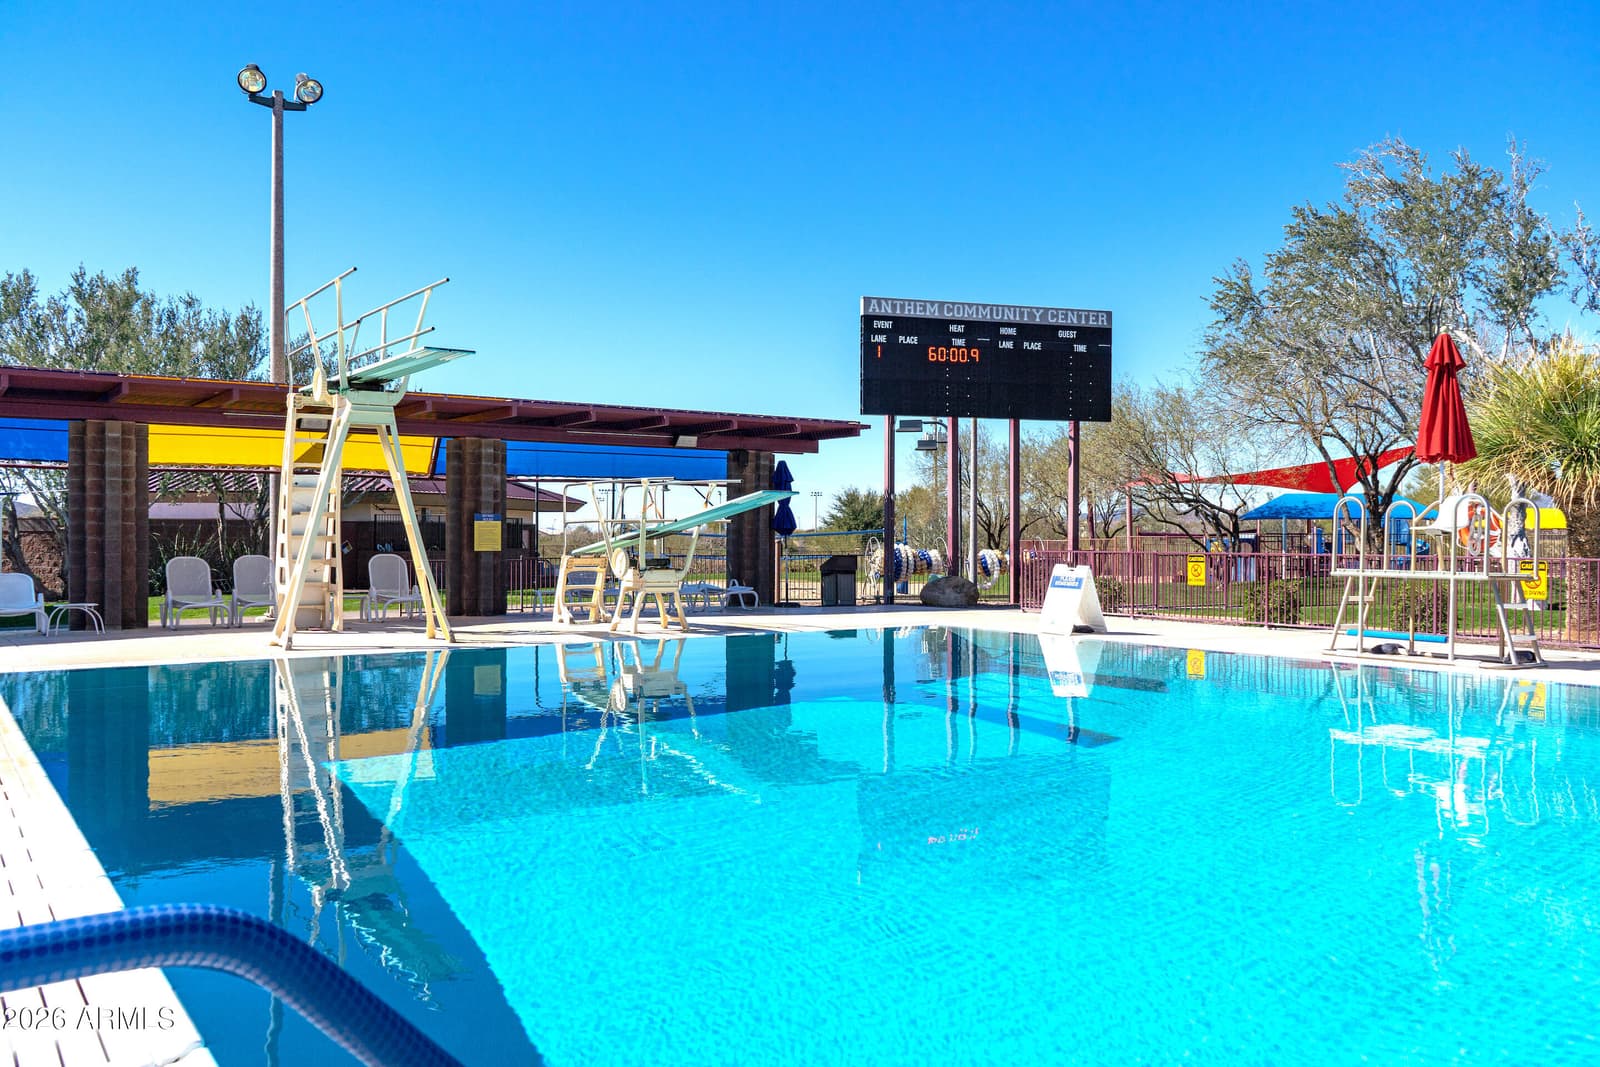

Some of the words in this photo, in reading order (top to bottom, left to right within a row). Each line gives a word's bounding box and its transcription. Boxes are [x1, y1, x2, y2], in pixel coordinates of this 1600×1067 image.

[868, 298, 939, 316] ANTHEM
[943, 303, 1044, 322] COMMUNITY
[1048, 309, 1107, 326] CENTER
[873, 320, 893, 329] EVENT
[949, 324, 965, 333] HEAT
[999, 327, 1017, 336] HOME
[1058, 330, 1078, 339] GUEST
[870, 334, 887, 343] LANE
[898, 335, 918, 345] PLACE
[951, 338, 966, 346] TIME
[998, 340, 1014, 349] LANE
[1023, 341, 1042, 350] PLACE
[1073, 344, 1087, 353] TIME
[876, 344, 882, 359] 1
[928, 346, 980, 363] 60:00.9
